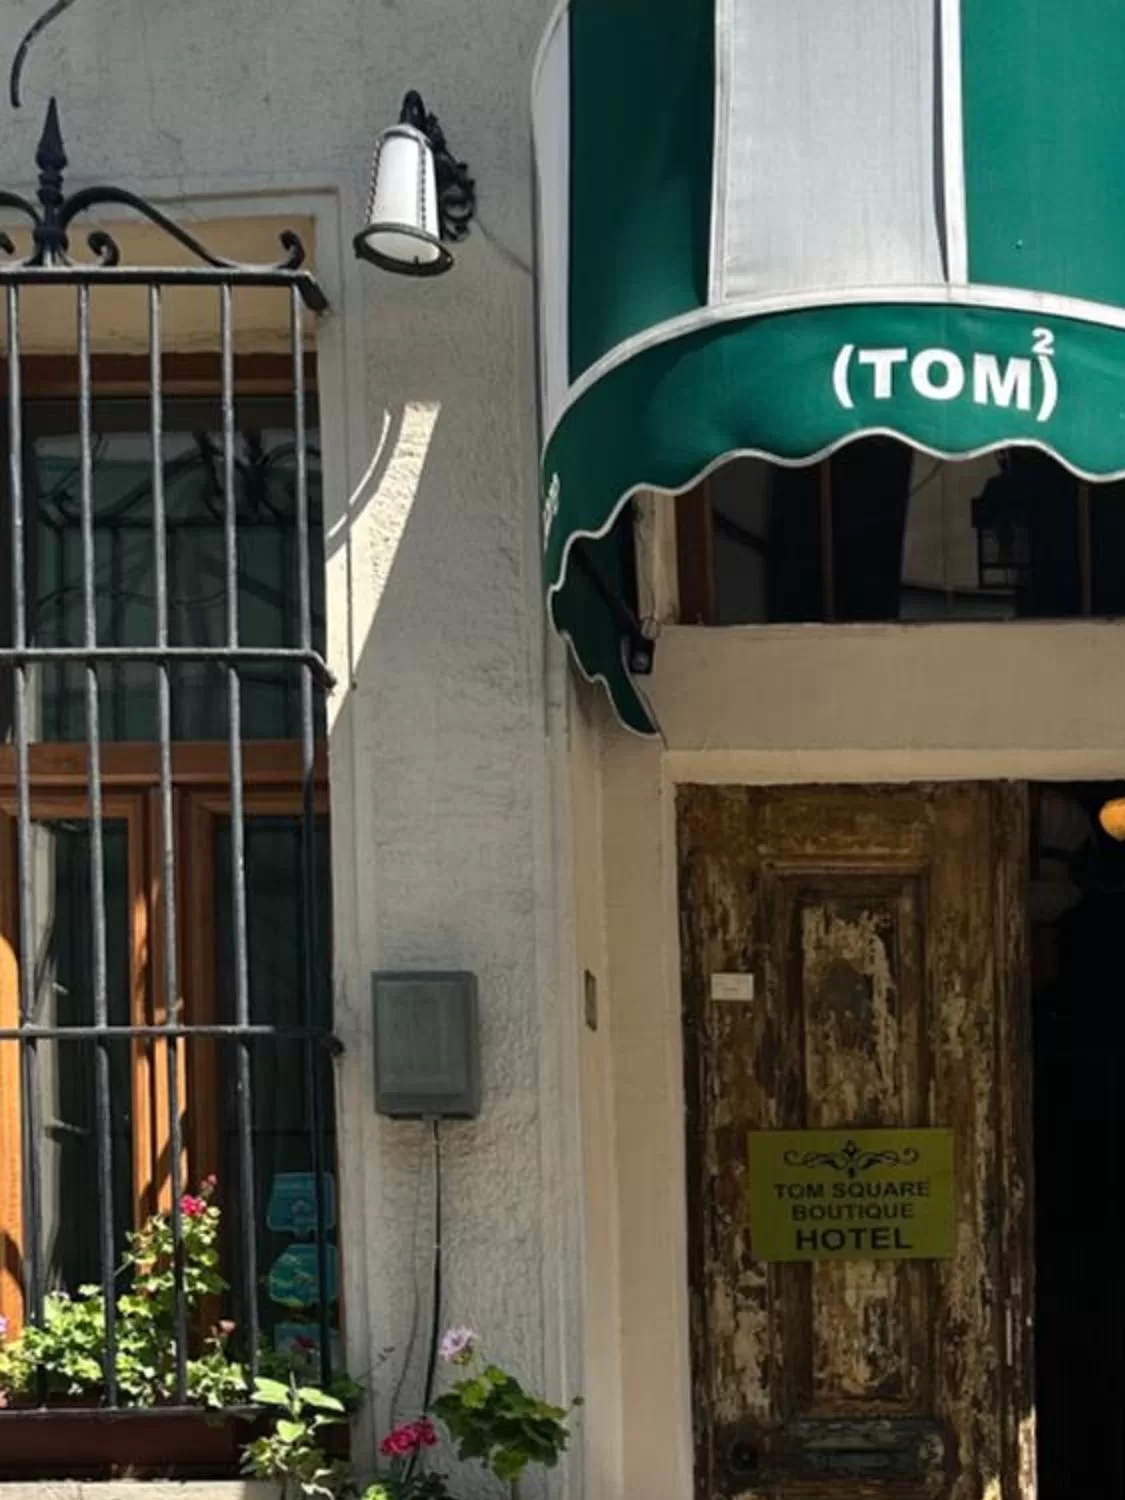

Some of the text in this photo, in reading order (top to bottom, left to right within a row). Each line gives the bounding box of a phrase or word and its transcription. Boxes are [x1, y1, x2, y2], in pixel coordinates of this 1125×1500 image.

[774, 1180, 929, 1199] TOM SQUARE
[791, 1203, 914, 1221] BOUTIQUE
[796, 1226, 913, 1251] HOTEL
